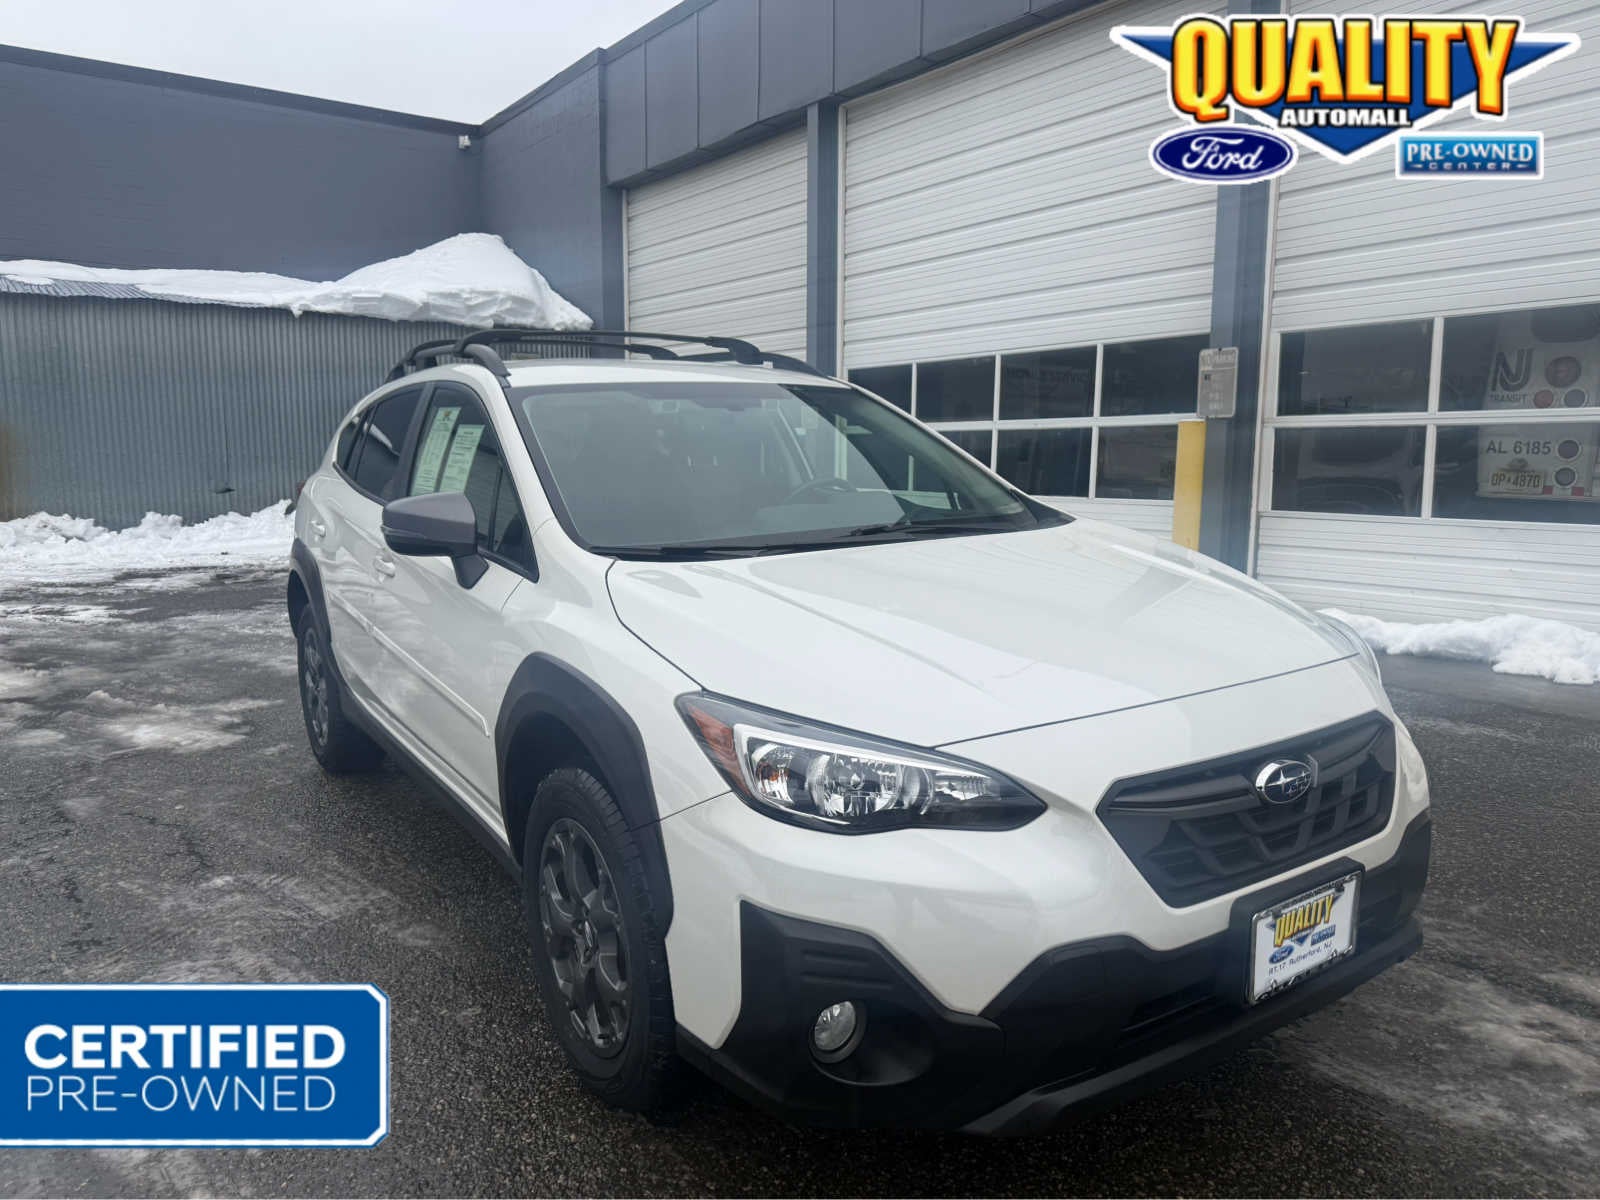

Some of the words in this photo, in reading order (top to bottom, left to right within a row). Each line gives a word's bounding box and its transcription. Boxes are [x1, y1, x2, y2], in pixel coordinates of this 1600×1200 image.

[1491, 348, 1535, 393] NJ
[1486, 440, 1507, 454] AL
[1513, 440, 1552, 455] 6185
[1273, 894, 1334, 948] QUALITY
